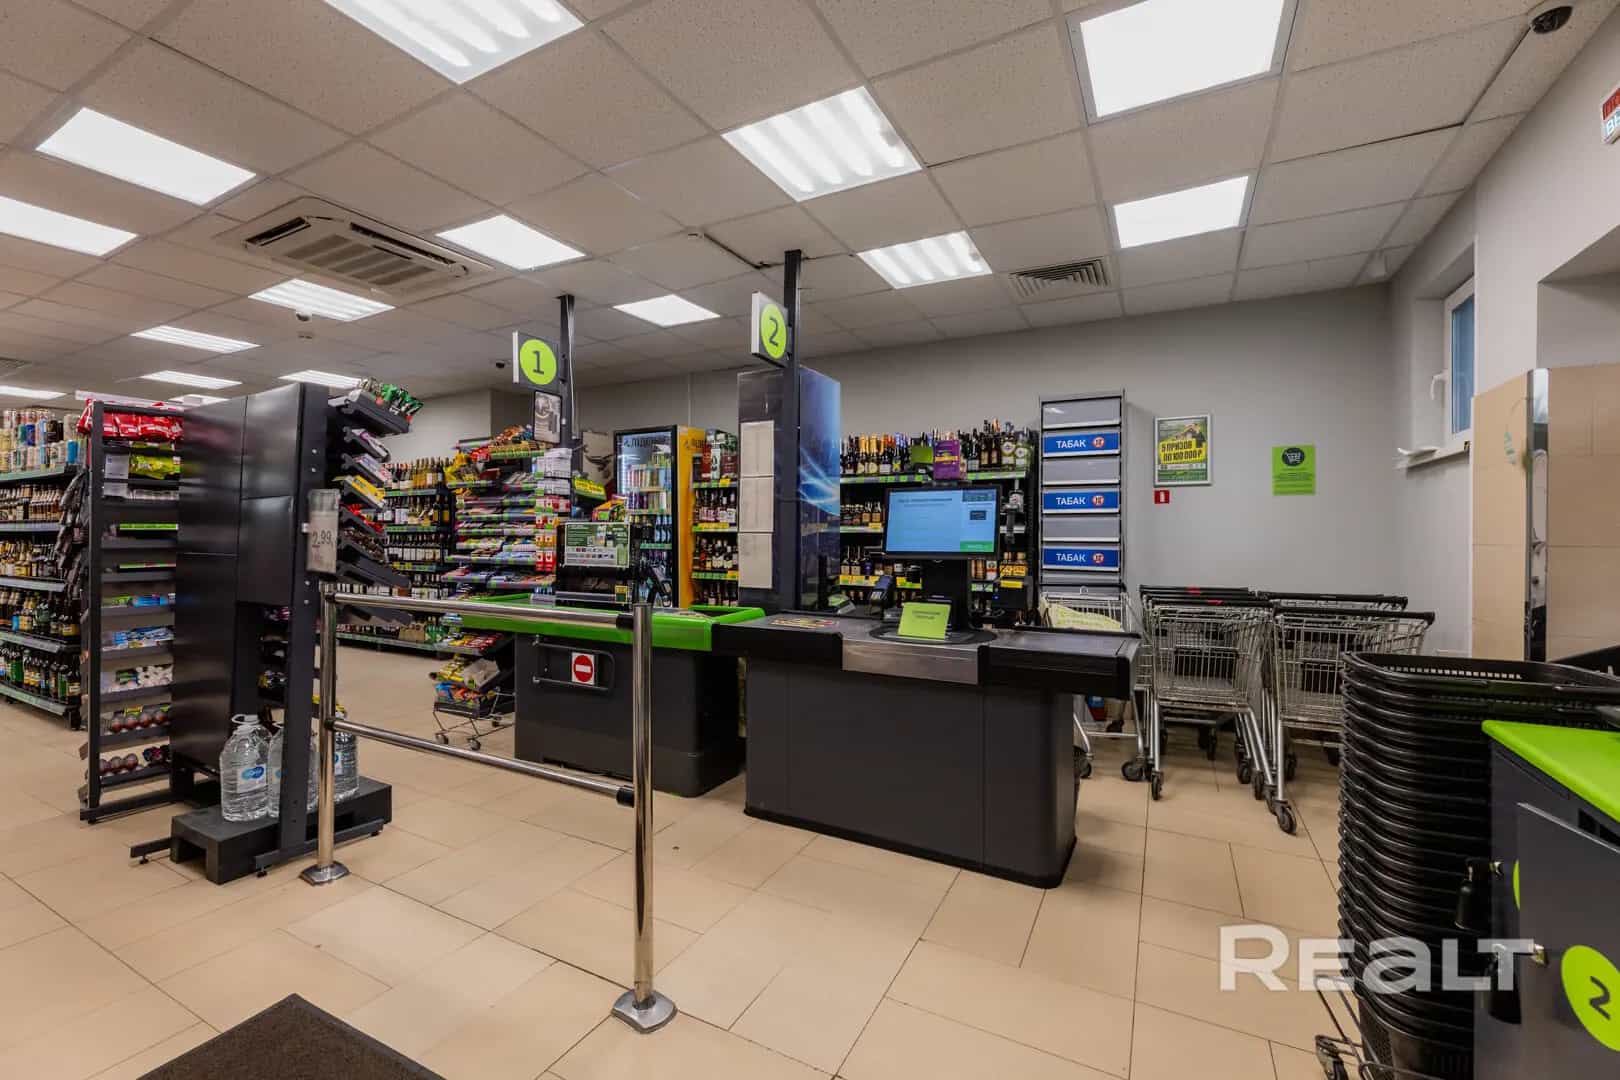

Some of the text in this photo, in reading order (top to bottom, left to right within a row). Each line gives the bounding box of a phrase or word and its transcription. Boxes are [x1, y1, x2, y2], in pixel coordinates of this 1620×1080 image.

[769, 316, 779, 347] 2
[532, 350, 545, 375] 1
[1056, 439, 1087, 448] ТАБАК
[1056, 496, 1086, 505] ТАБАК
[1056, 553, 1087, 562] ТАБАК
[1589, 975, 1611, 1021] 2
